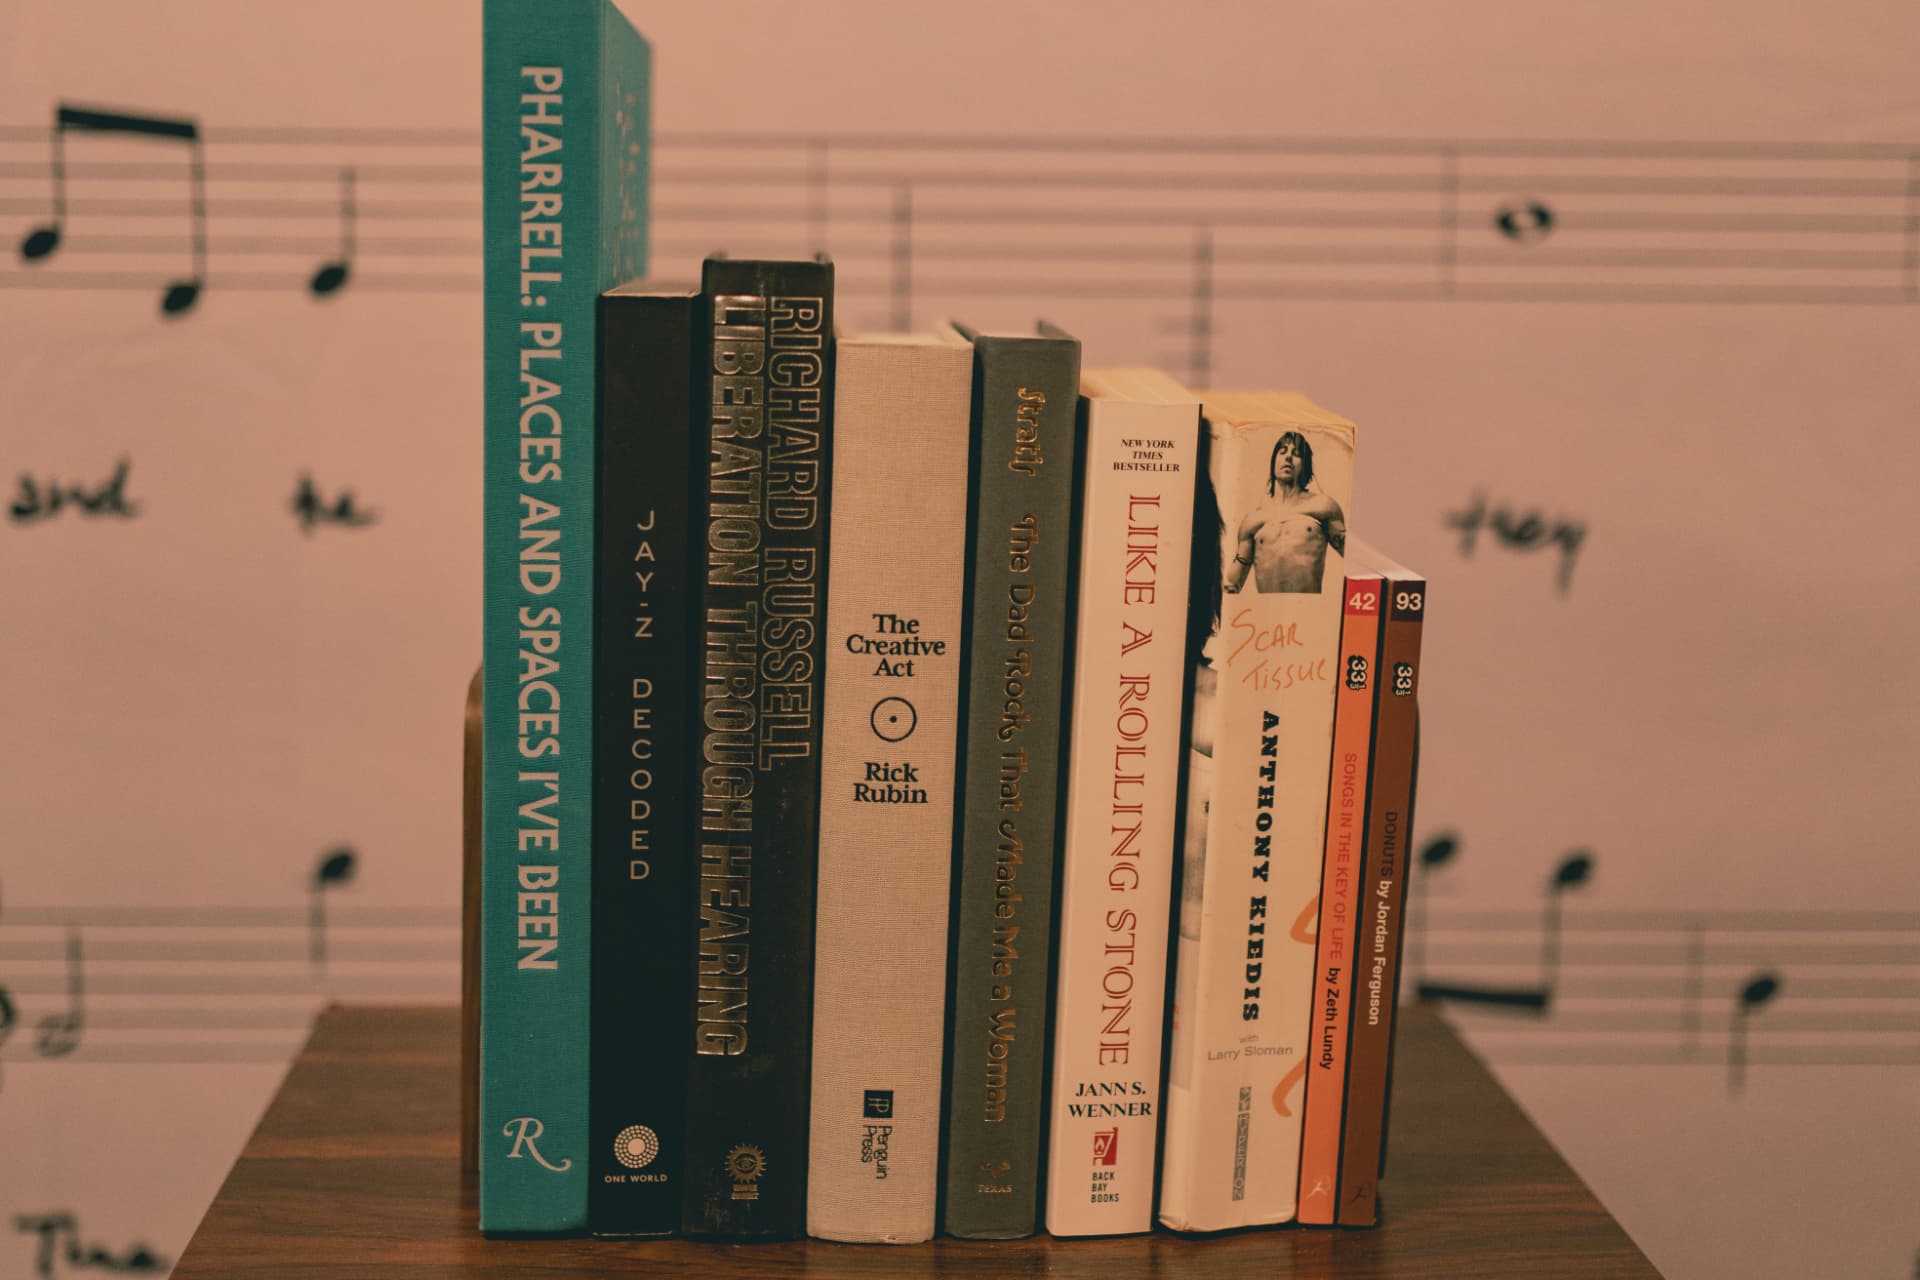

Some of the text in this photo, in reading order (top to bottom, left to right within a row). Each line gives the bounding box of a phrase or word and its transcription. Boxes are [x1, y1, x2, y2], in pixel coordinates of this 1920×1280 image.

[1121, 439, 1175, 449] NEW YORK
[1132, 450, 1164, 460] TIMES
[1113, 462, 1180, 473] BESTSELLER
[516, 66, 564, 971] PHARRELL: PLACES AND SPACES I'VE BEEN
[759, 296, 824, 771] RICHARD RUSSELL
[1009, 513, 1041, 574] The
[1007, 584, 1036, 643] Dad
[1349, 591, 1376, 611] 42
[1396, 592, 1422, 611] 93
[872, 613, 920, 635] The
[1226, 608, 1304, 668] SCAR
[846, 634, 946, 656] Creative
[695, 295, 765, 1057] LIBERATION THROUGH HEARING
[873, 658, 915, 677] Act
[630, 509, 656, 881] JAY-Z DECODED
[996, 649, 1034, 742] Rock
[863, 762, 919, 783] Rick
[999, 746, 1031, 812] That
[1099, 493, 1161, 1067] LIKE A ROLLING STONE
[853, 783, 929, 804] Rubin
[994, 819, 1025, 919] Made
[1242, 710, 1281, 1022] ANTHONY KIEDIS
[1319, 752, 1358, 1071] SONGS IN THE KEY OF LIFE by Zeth Lundy
[1367, 810, 1399, 1026] DONUTS by Jordan Ferguson
[991, 926, 1022, 977] Me
[989, 984, 1012, 1002] a
[1208, 1045, 1293, 1062] Larry Sloman
[1239, 1034, 1260, 1043] with
[983, 1009, 1017, 1124] Woman
[1075, 1081, 1146, 1097] JANN S.
[1068, 1102, 1152, 1118] WENNER
[502, 1117, 571, 1172] R
[861, 1124, 877, 1163] Press
[873, 1125, 893, 1179] Penguin
[604, 1173, 668, 1183] ONE WORLD
[1091, 1183, 1108, 1192] BAY
[1092, 1172, 1115, 1182] BACK
[1090, 1193, 1120, 1203] BOOKS
